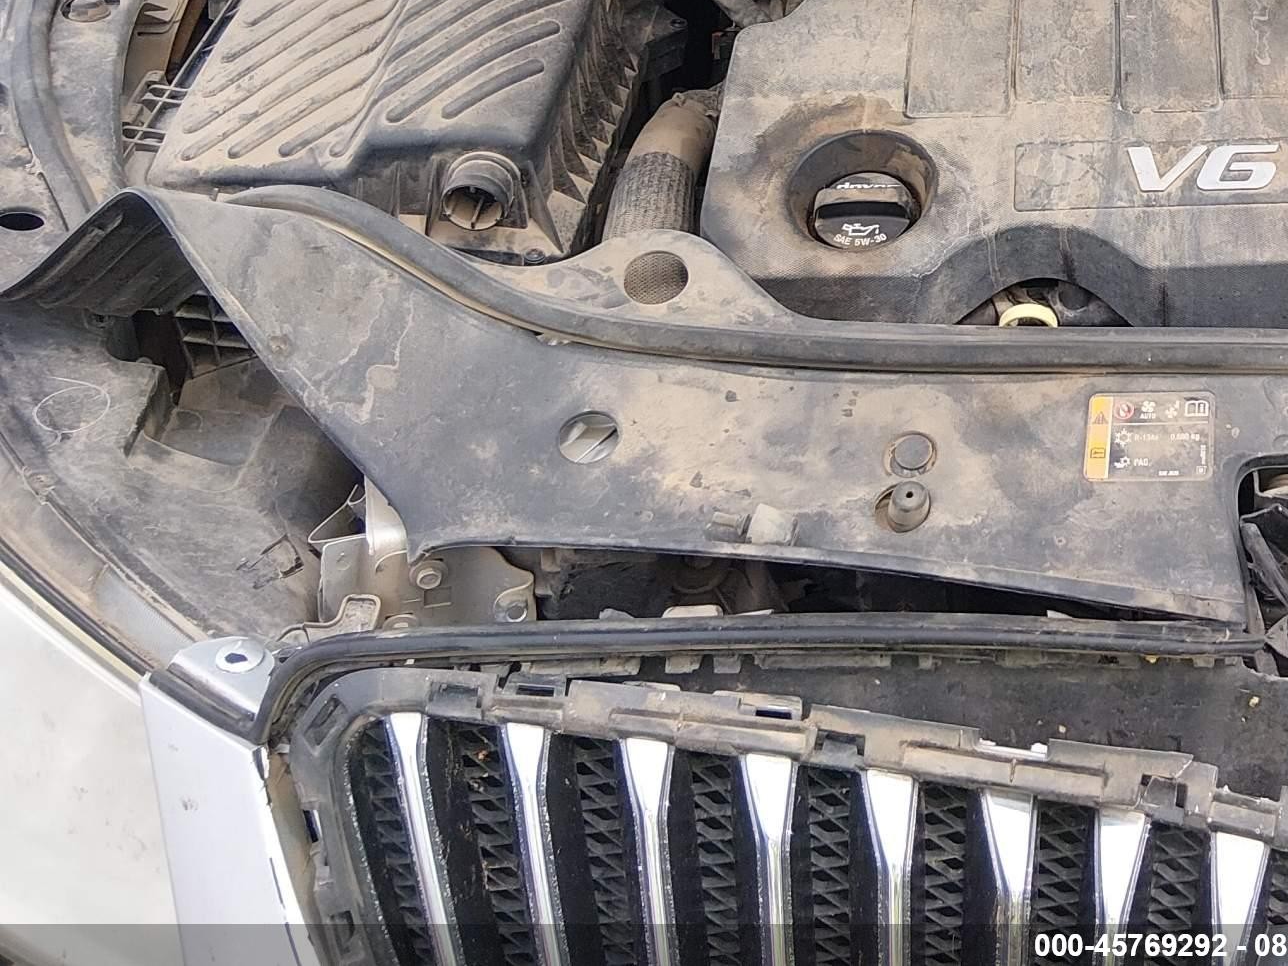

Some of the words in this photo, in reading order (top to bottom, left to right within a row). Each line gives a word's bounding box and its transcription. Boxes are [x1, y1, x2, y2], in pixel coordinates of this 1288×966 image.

[1127, 144, 1280, 192] V6
[833, 234, 852, 245] SAE
[854, 233, 888, 246] 5W-30
